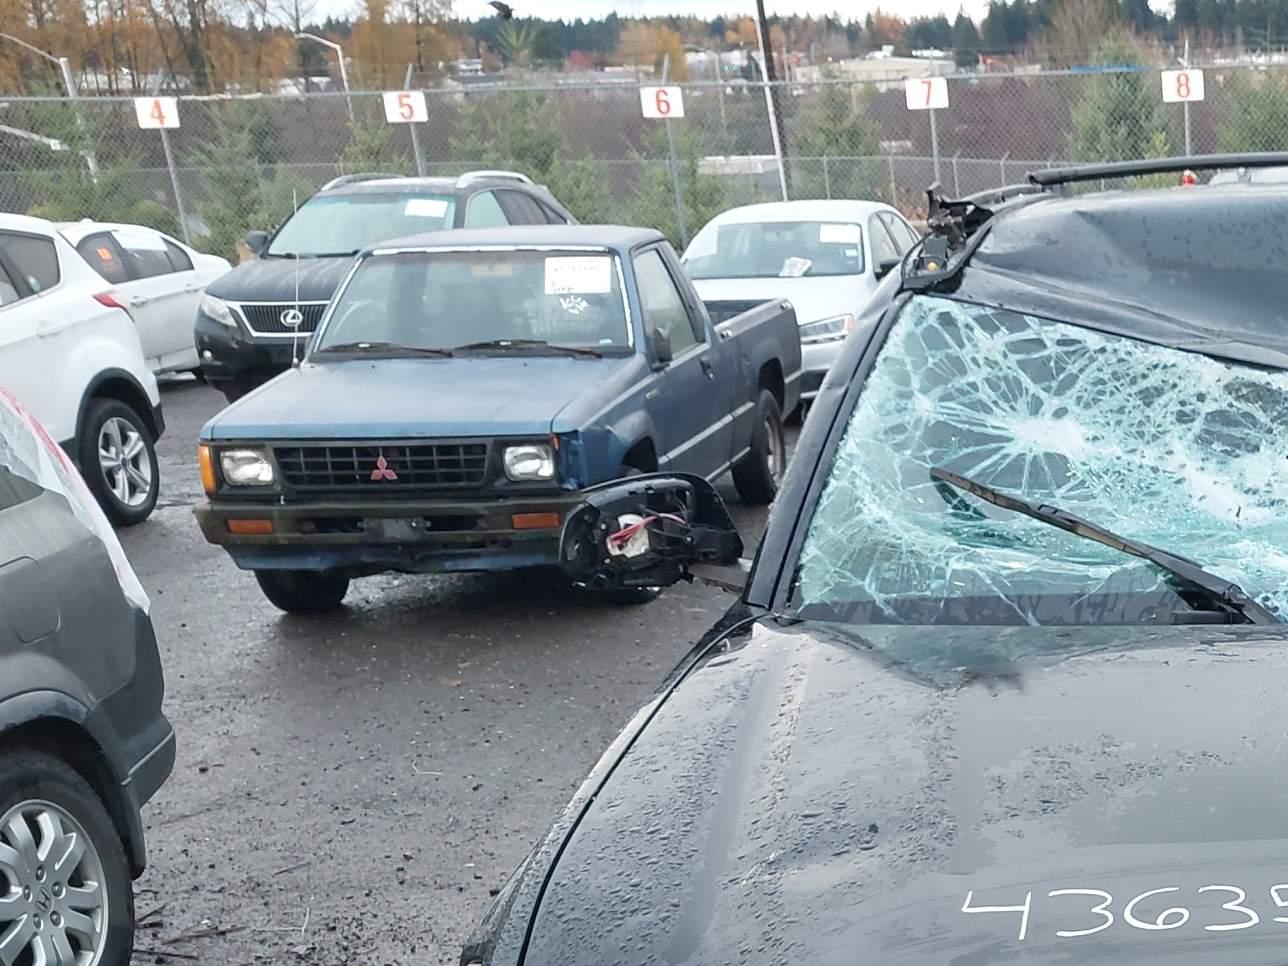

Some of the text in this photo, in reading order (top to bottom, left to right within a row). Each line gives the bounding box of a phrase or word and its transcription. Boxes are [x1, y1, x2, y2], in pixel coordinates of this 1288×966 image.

[922, 80, 934, 106] 7
[1177, 74, 1190, 99] 8
[150, 99, 165, 124] 4
[399, 94, 413, 119] 5
[656, 90, 670, 115] 6
